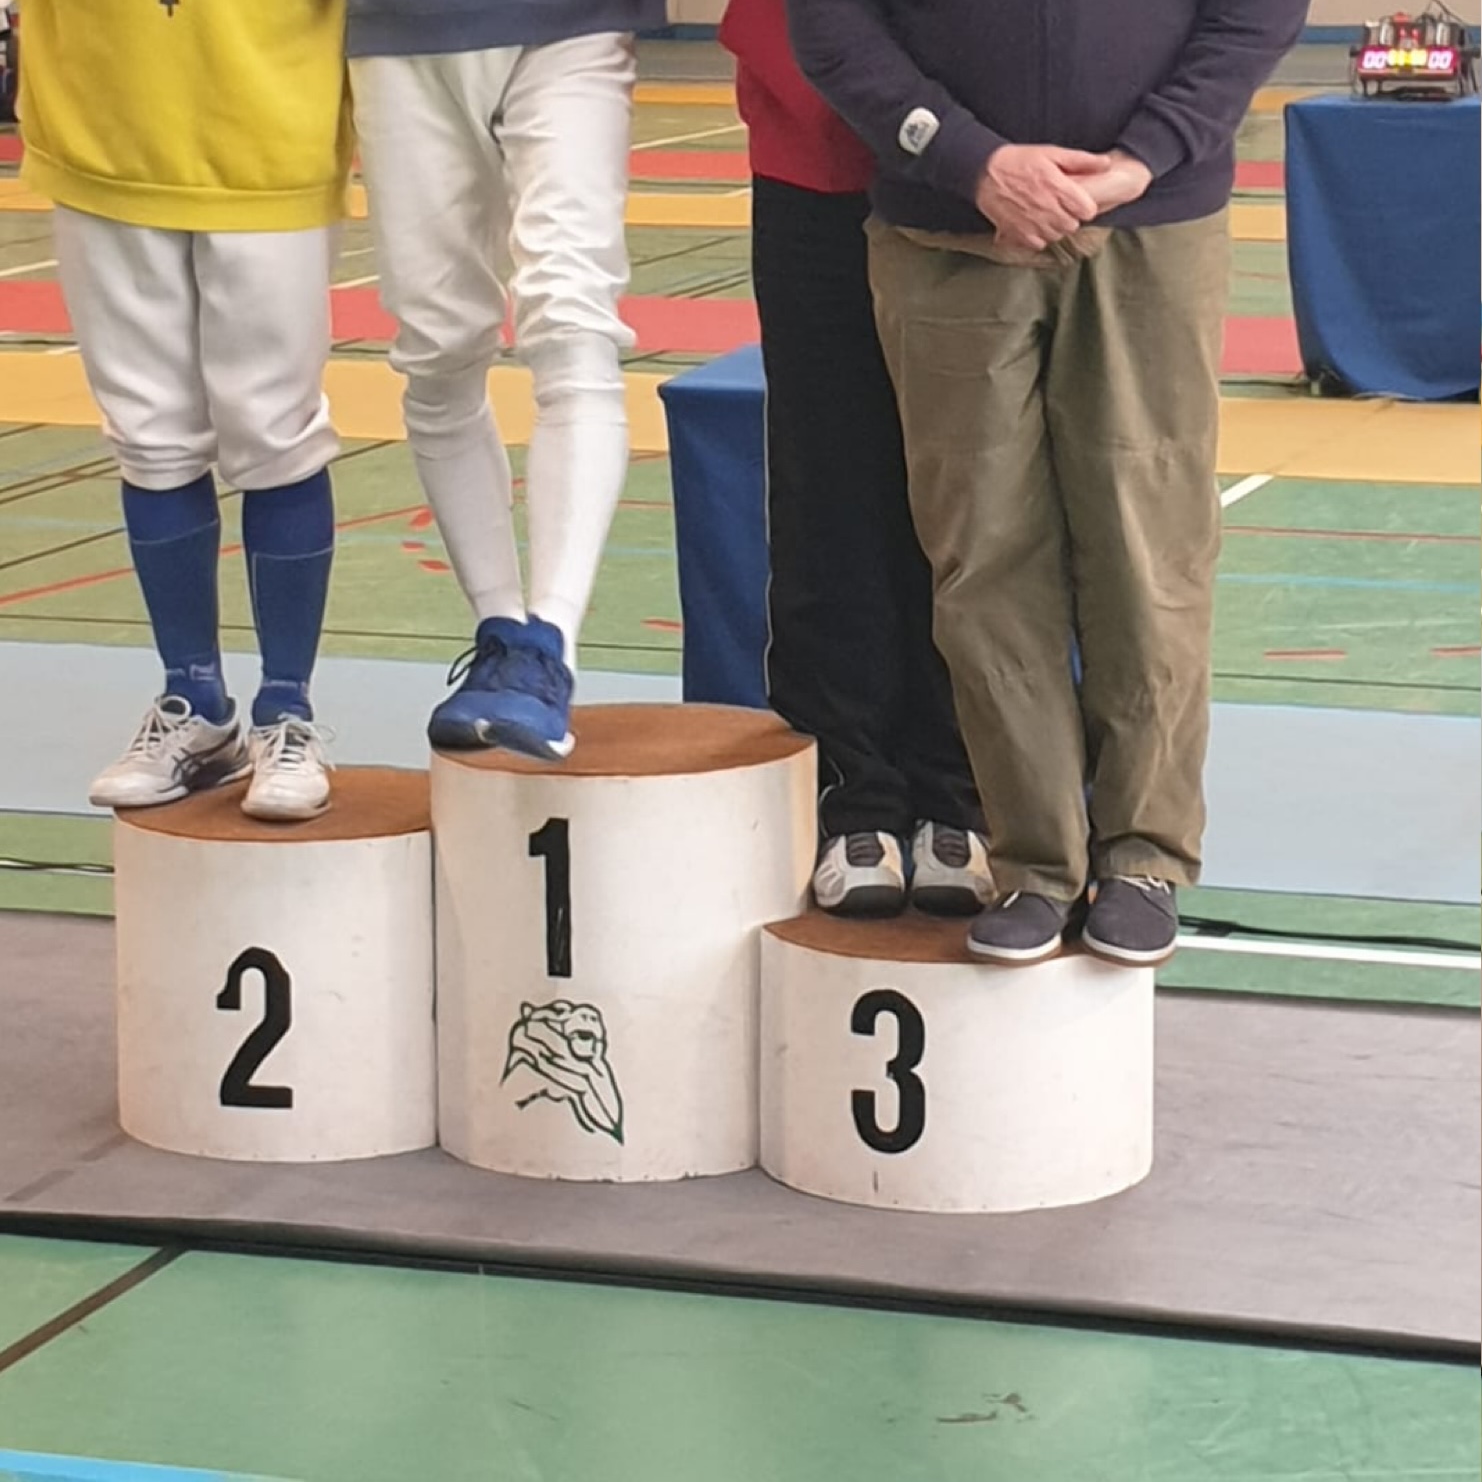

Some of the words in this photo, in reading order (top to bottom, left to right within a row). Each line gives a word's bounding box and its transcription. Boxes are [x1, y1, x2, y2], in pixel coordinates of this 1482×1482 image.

[527, 816, 573, 979] 1
[215, 946, 294, 1110] 2
[849, 988, 926, 1155] 3
